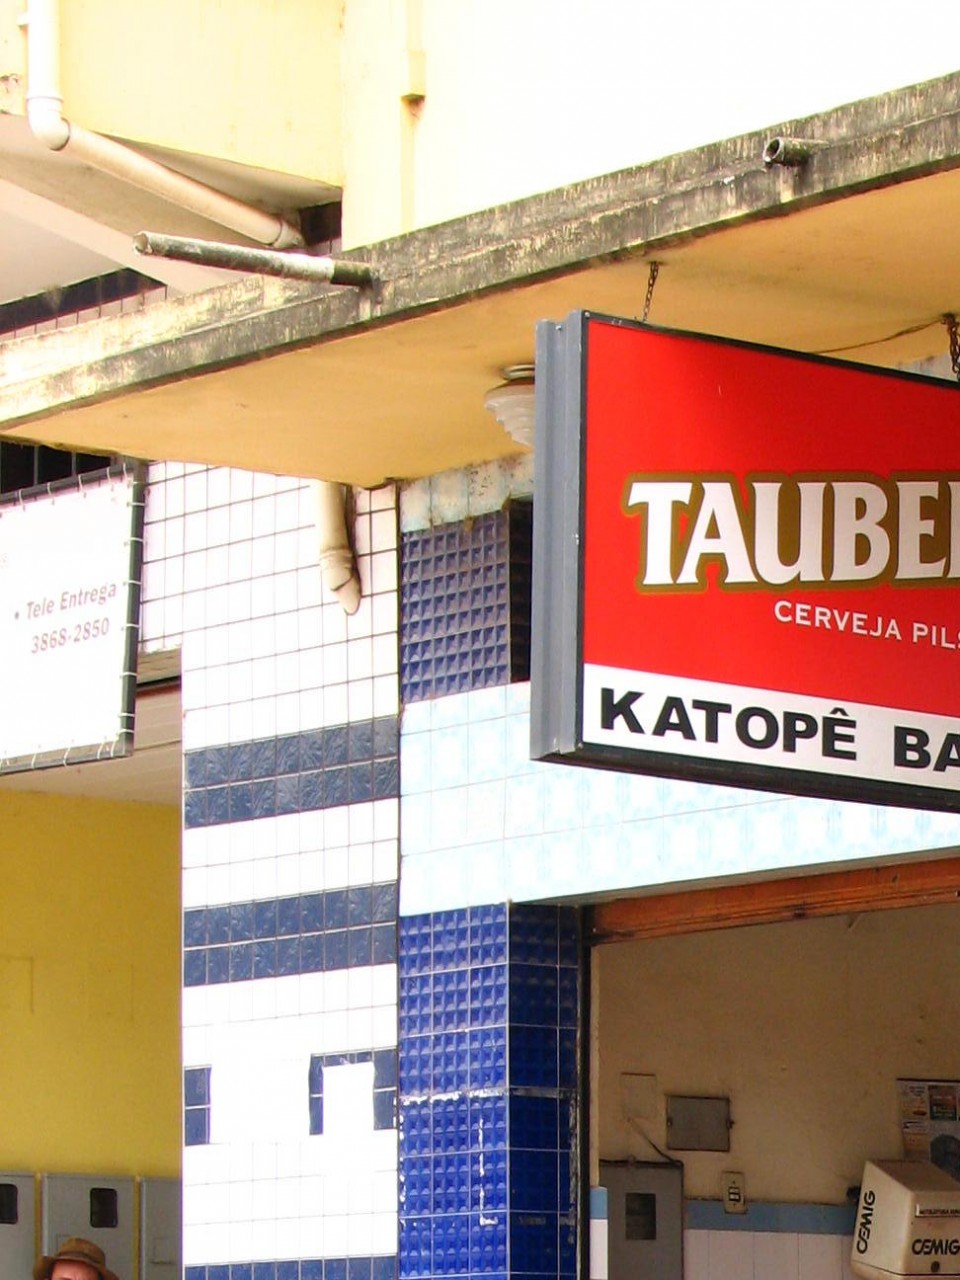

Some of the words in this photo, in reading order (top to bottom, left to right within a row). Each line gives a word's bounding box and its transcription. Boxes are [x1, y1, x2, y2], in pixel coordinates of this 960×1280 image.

[26, 597, 55, 620] Tele
[60, 582, 117, 611] Entrega
[773, 600, 902, 641] CERVEJA
[600, 686, 858, 761] KATOPÊ
[856, 1190, 876, 1254] CEMIG
[911, 1238, 960, 1256] CEMIG
